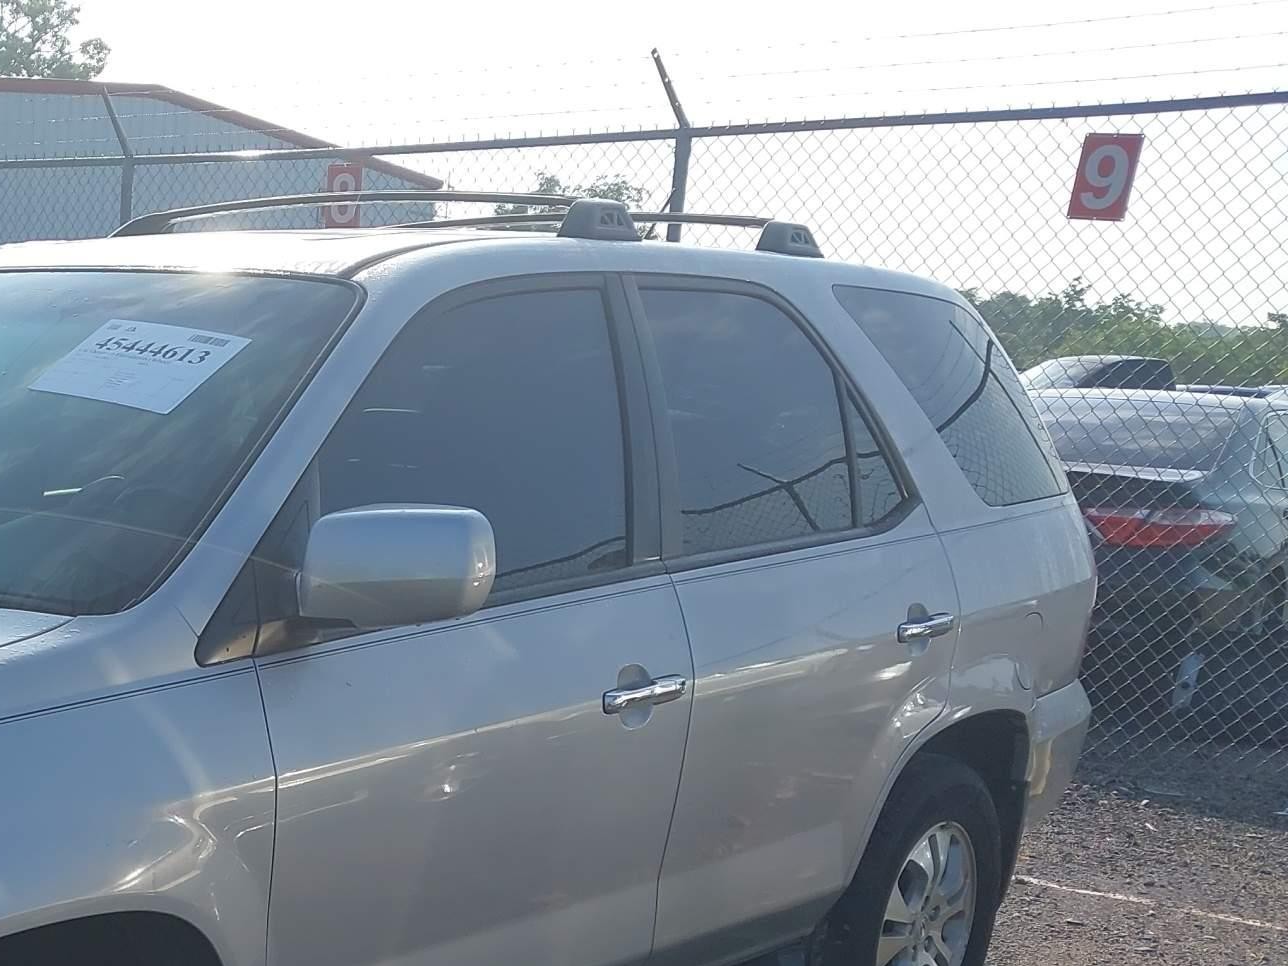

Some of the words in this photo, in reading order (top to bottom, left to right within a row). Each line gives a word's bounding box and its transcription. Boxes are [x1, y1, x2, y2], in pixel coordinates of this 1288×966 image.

[330, 172, 356, 224] 8
[1079, 144, 1129, 210] 9
[95, 336, 211, 365] 45444613
